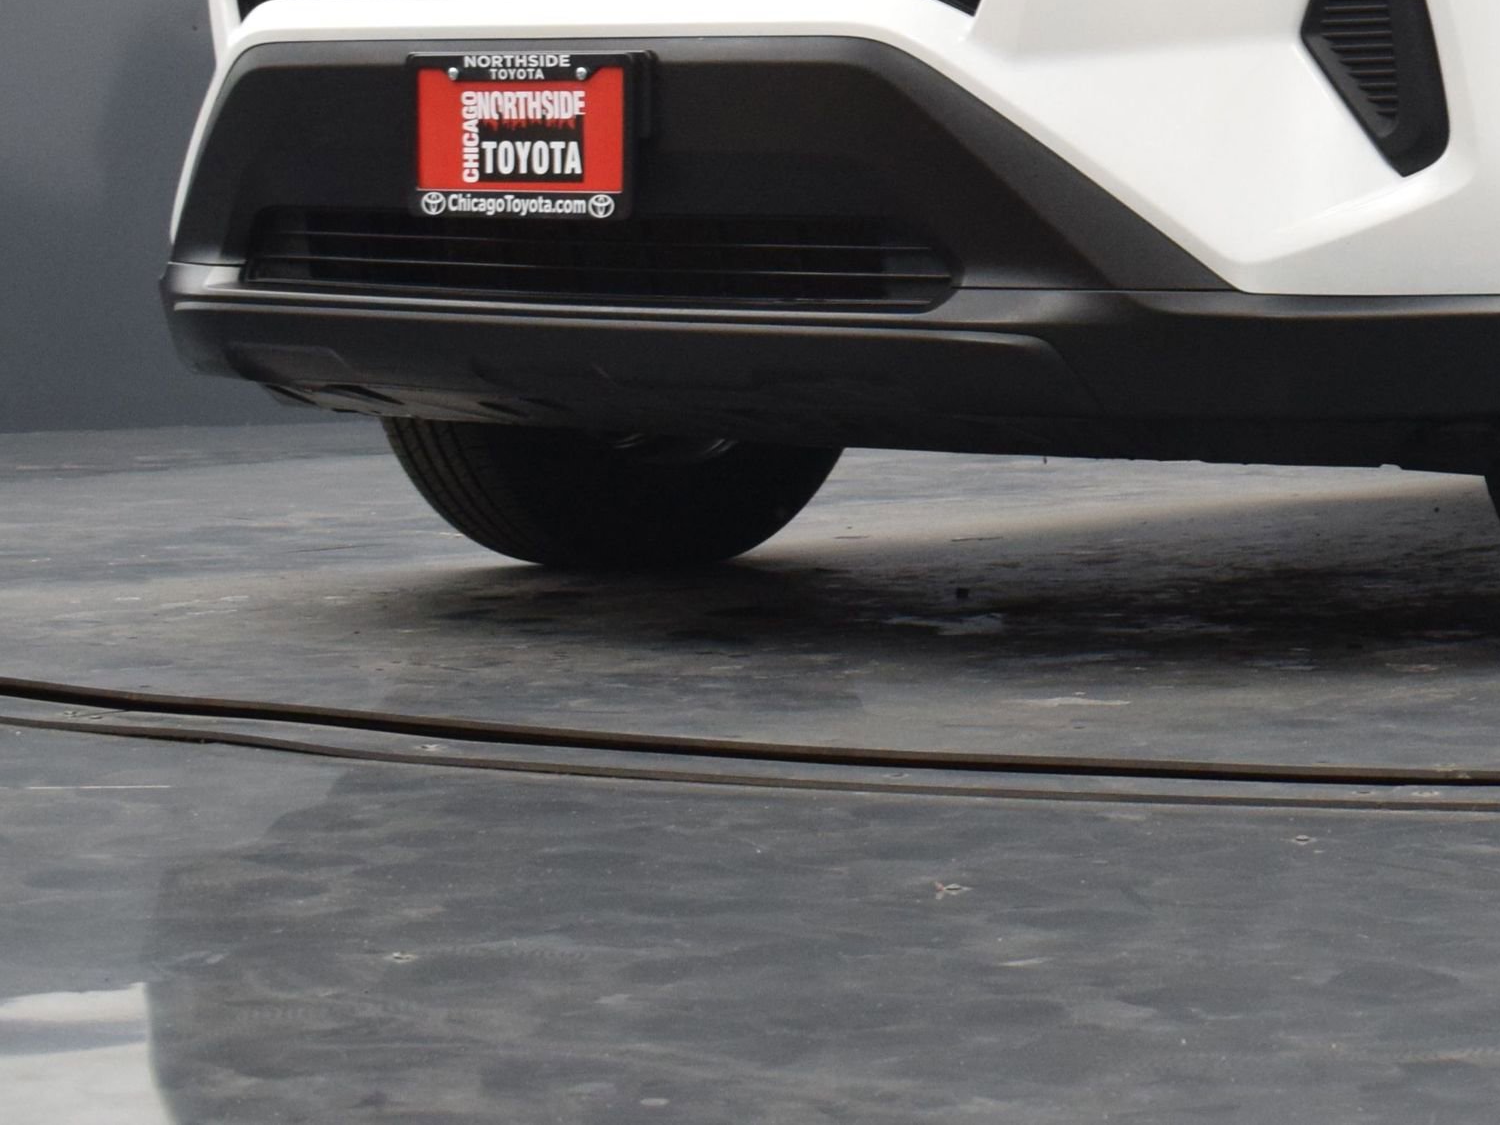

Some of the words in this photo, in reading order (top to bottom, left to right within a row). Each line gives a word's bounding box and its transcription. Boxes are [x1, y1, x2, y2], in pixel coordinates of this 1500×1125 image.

[464, 54, 571, 68] NORTHSIDE
[489, 68, 544, 80] TOYOTA
[476, 90, 586, 120] NORTHSIDE
[461, 91, 480, 183] CHICAGO
[481, 140, 583, 175] TOYOTA
[449, 194, 586, 216] ChicagoToyota.com
